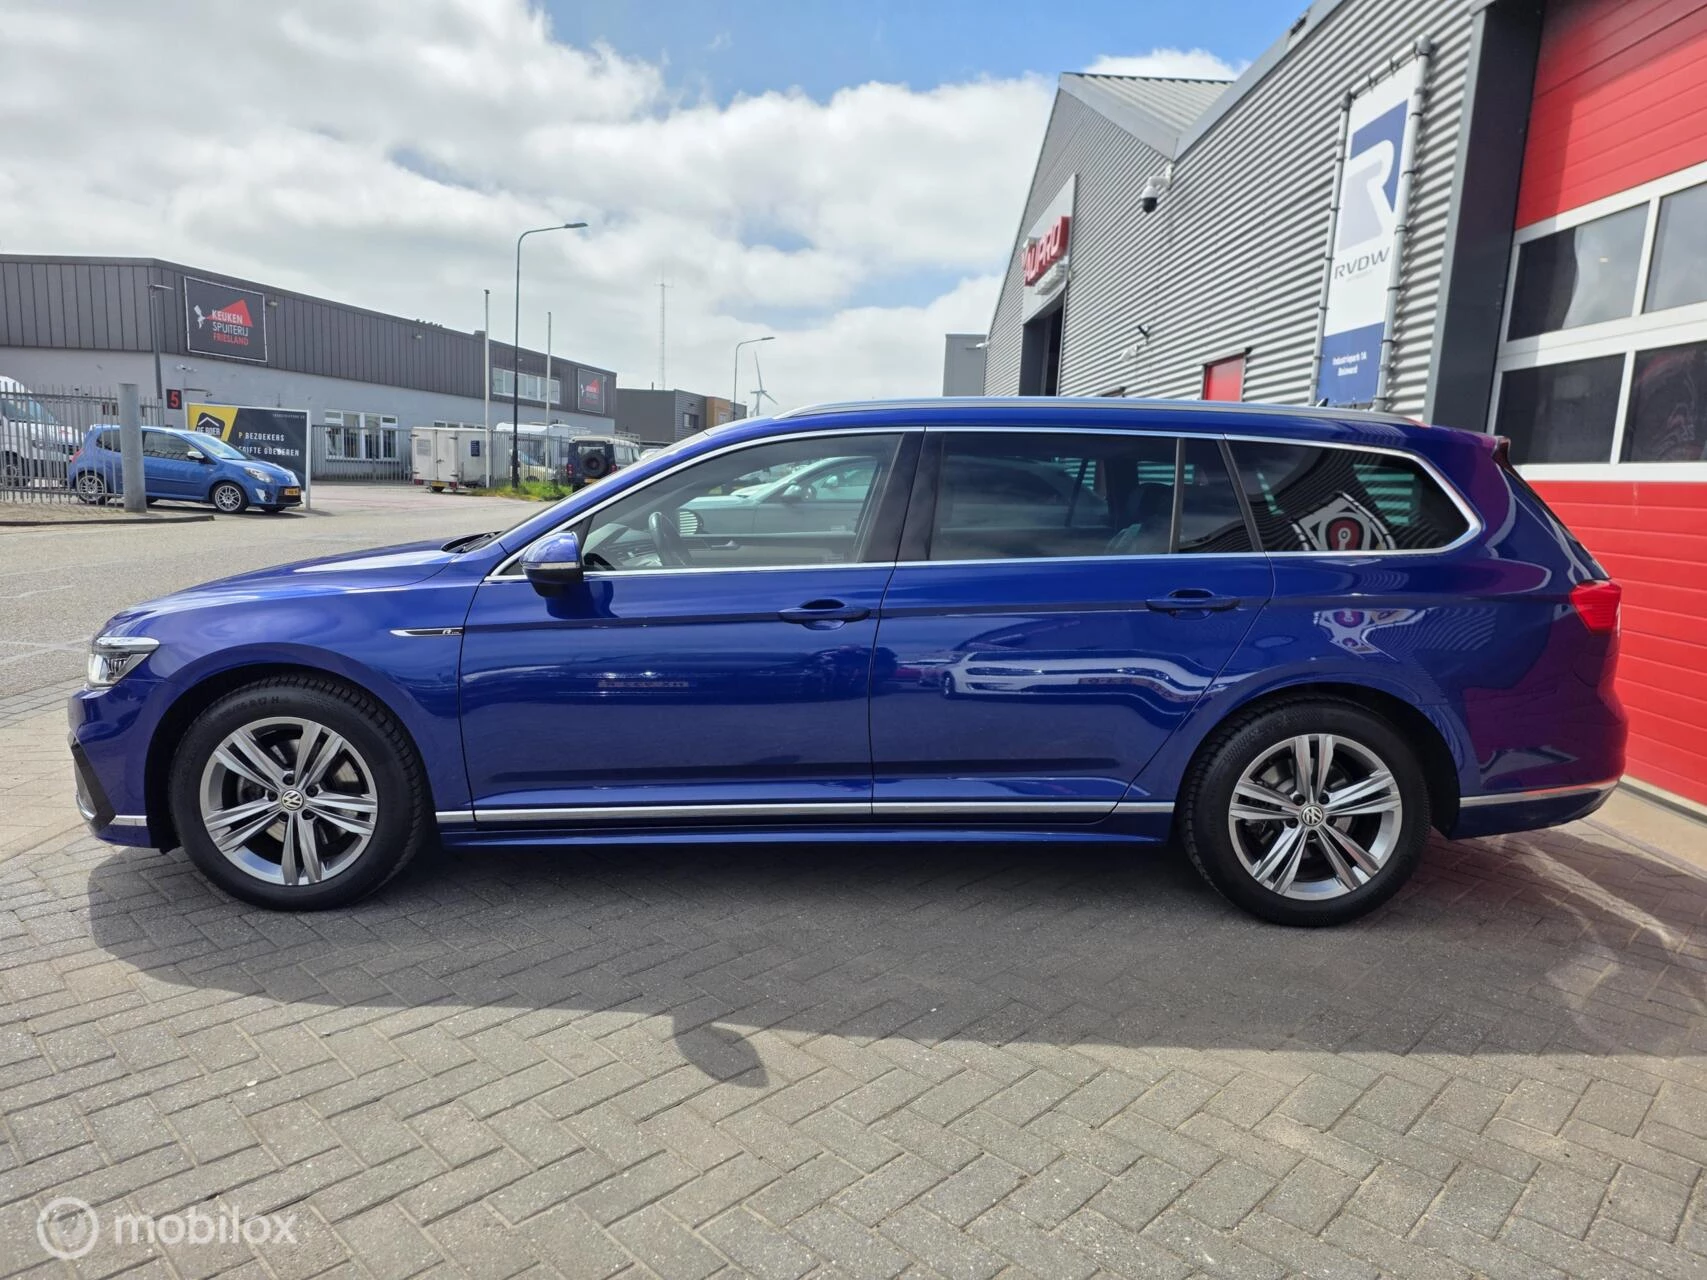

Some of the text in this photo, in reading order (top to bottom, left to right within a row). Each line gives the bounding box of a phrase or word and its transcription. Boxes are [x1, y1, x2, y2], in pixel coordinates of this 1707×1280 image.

[1334, 247, 1390, 279] RVDW
[212, 309, 243, 325] KEUKEN
[212, 321, 249, 336] SPUITERIJ
[170, 391, 179, 407] 5
[245, 432, 285, 442] BEZOEKERS
